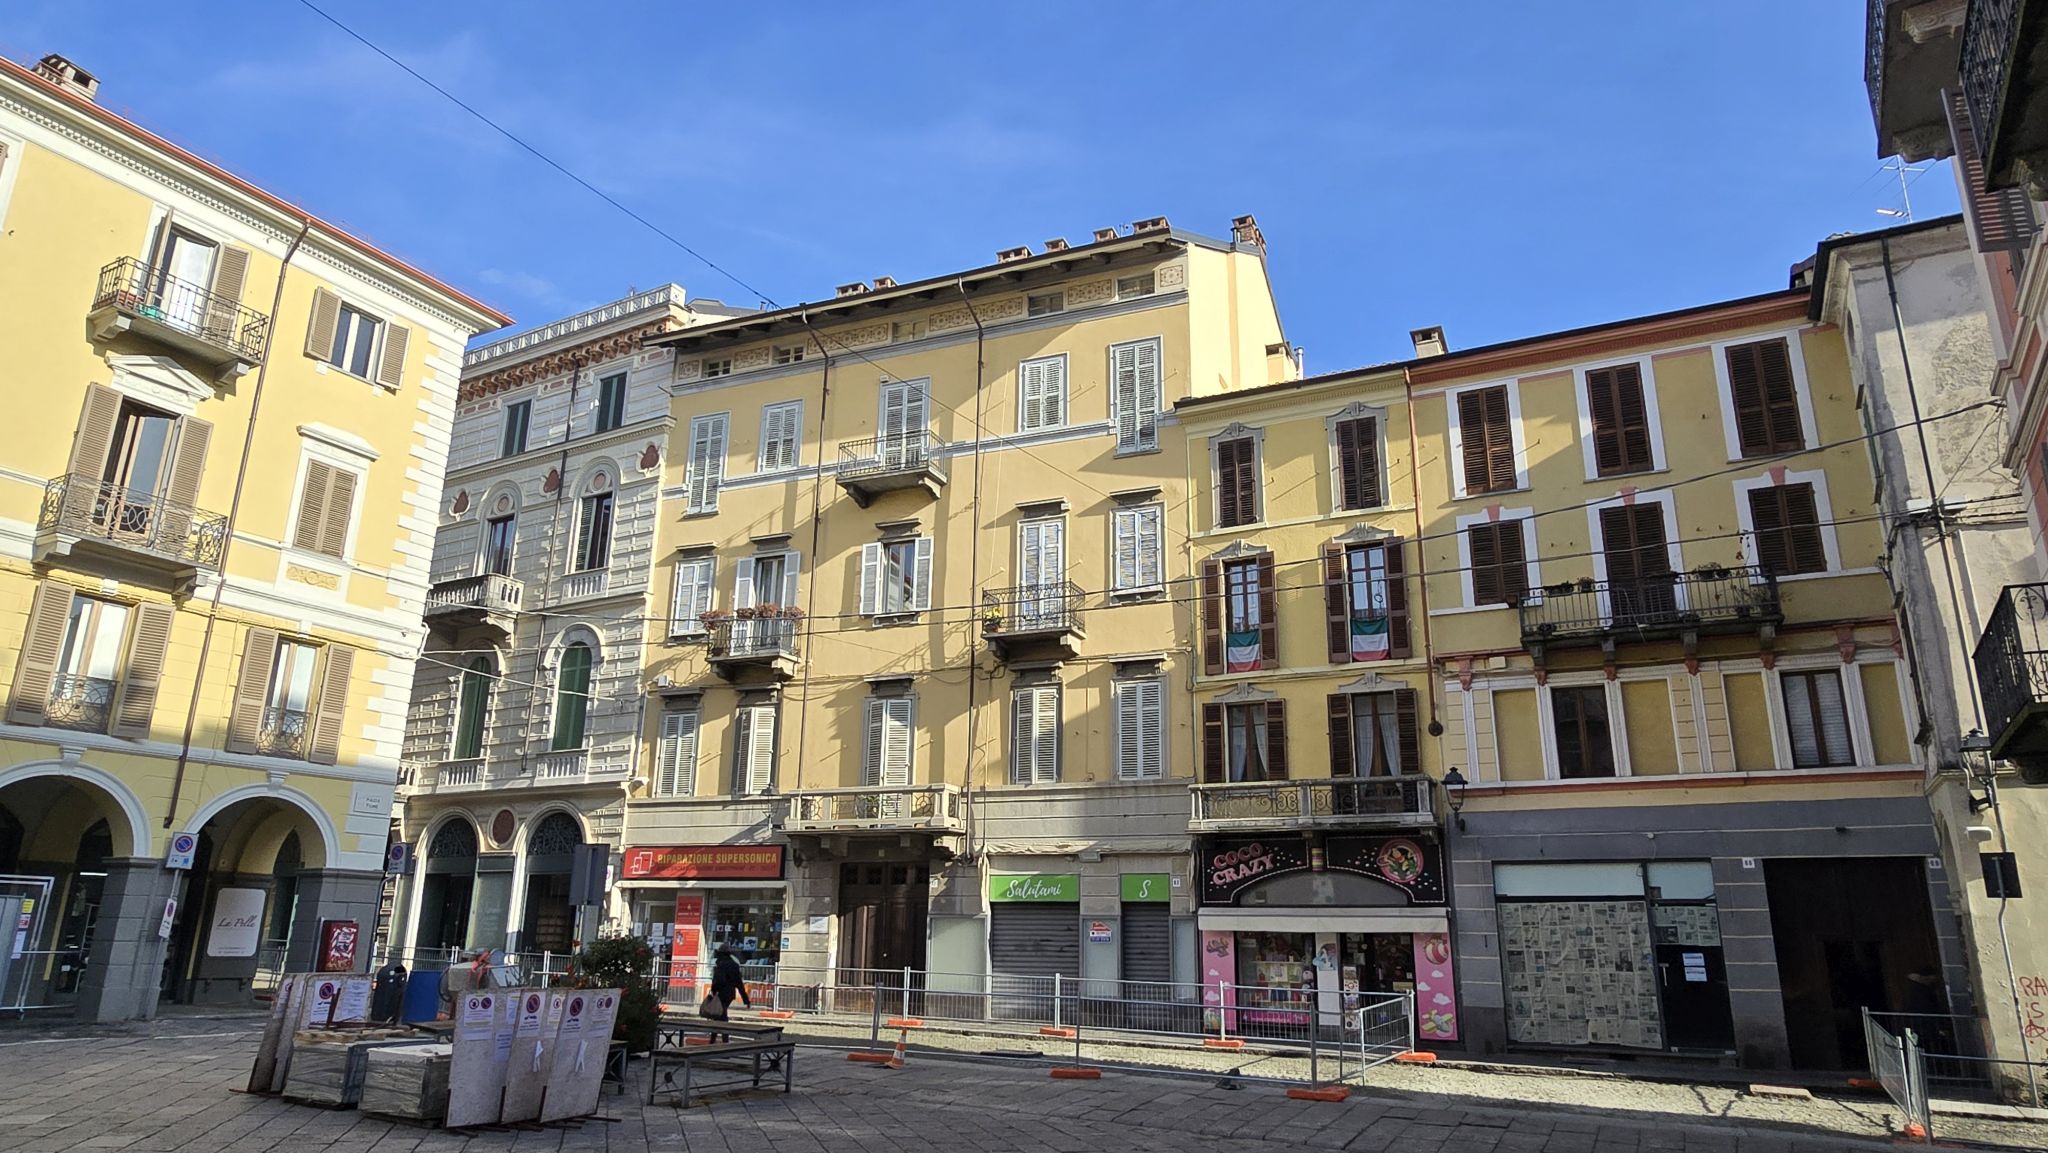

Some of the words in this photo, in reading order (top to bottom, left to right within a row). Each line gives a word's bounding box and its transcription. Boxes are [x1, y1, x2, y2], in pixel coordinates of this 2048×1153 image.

[657, 853, 714, 864] RIPARAZIONE
[716, 852, 777, 864] SUPERSONICA
[1213, 842, 1264, 870] COCO
[1212, 853, 1275, 886] CRAZY
[1006, 879, 1062, 899] Salutami
[1139, 879, 1152, 898] S
